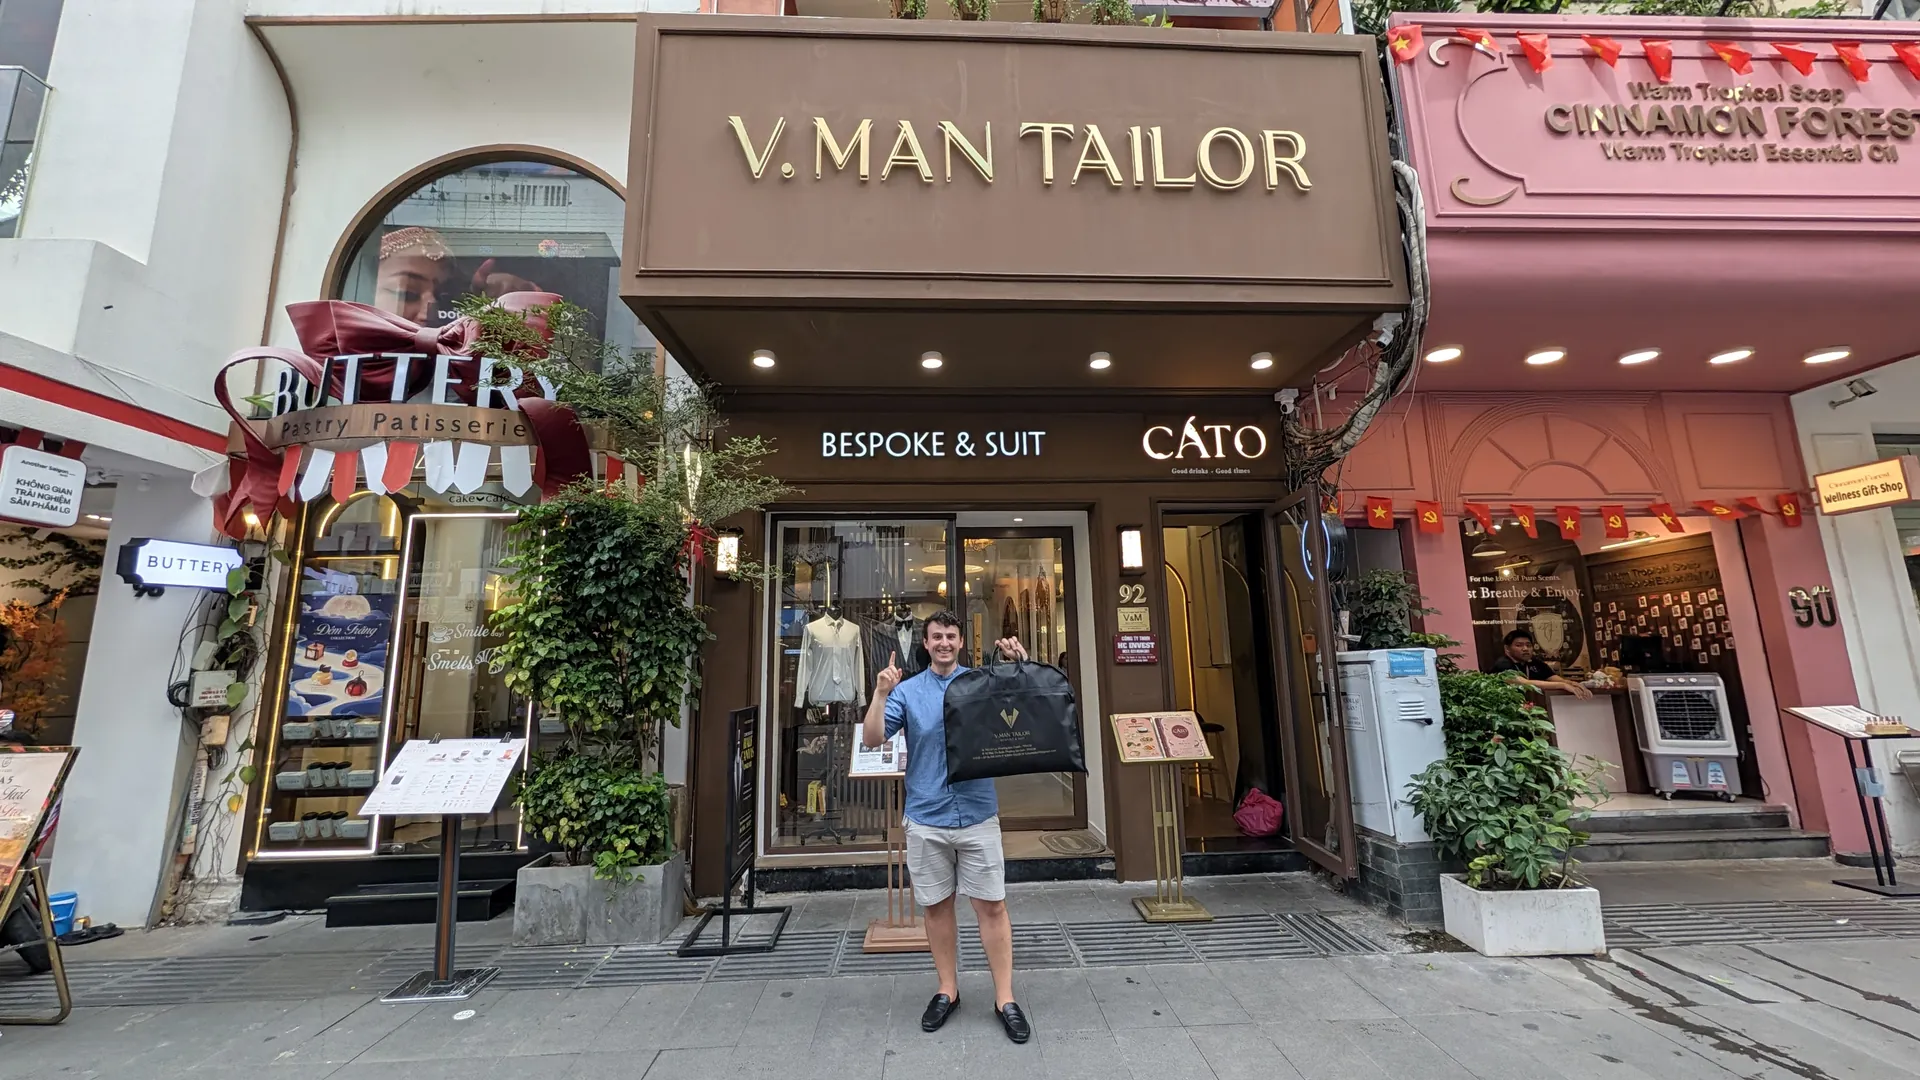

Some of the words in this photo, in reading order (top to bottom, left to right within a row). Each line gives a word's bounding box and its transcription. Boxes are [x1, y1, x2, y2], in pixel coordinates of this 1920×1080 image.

[1627, 81, 1692, 100] Warm
[1696, 81, 1784, 105] Tropical
[1790, 84, 1845, 106] Soap
[1544, 103, 1767, 138] CINNAMON
[1019, 122, 1313, 191] TAILOR
[1600, 142, 1666, 161] Warm
[1670, 142, 1758, 165] Tropical
[1762, 143, 1863, 163] Essential
[1867, 143, 1899, 163] Oil
[272, 353, 564, 417] BUTTERY
[281, 417, 349, 440] Pastry
[373, 412, 527, 438] Patisserie
[822, 431, 945, 457] BESPOKE
[955, 431, 976, 457] &
[985, 431, 1046, 456] SUIT
[16, 478, 51, 492] KHÔNG
[51, 485, 73, 496] GIAN
[1824, 490, 1861, 504] Wellness
[1862, 485, 1880, 497] Gift
[1880, 481, 1903, 493] Shop
[37, 492, 71, 505] NGHIỆM
[448, 494, 476, 503] cake
[59, 506, 71, 514] LG
[147, 555, 235, 573] BUTTERY
[1119, 584, 1147, 604] 92
[1481, 586, 1529, 599] Breathe
[1531, 586, 1542, 598] &
[1546, 585, 1584, 601] Enjoy.
[1788, 585, 1837, 628] 90
[454, 623, 490, 639] Smile
[427, 652, 475, 671] Smells
